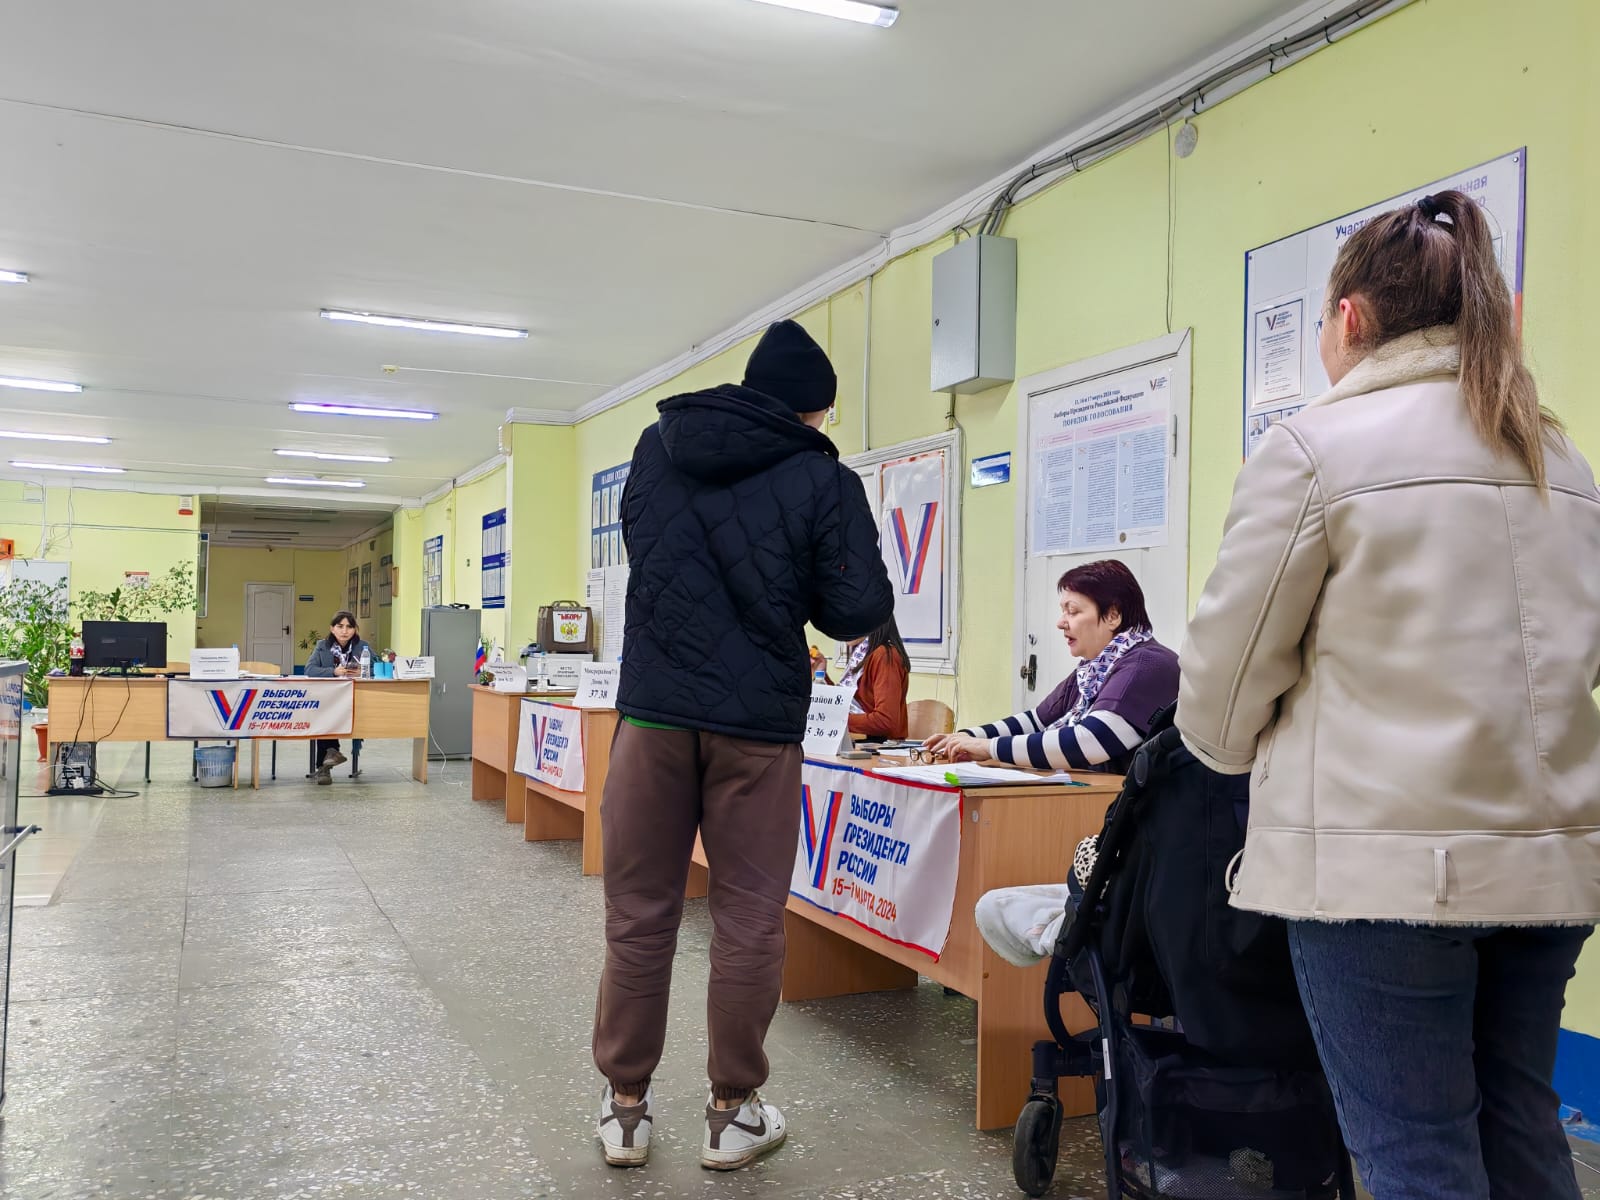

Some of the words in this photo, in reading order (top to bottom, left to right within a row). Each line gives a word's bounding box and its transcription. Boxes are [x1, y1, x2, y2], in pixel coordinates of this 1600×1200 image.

[1336, 218, 1371, 239] Участк
[1094, 397, 1119, 409] Российской
[1062, 415, 1088, 427] ПОРЯДОК
[1089, 404, 1133, 420] ГОЛОСОВАНИЯ
[262, 689, 307, 698] ВЫБОРЫ
[257, 700, 320, 709] ПРЕЗИДЕНТА
[252, 712, 293, 720] РОССИИ
[816, 713, 826, 721] №
[814, 728, 824, 736] 36
[851, 794, 896, 828] ВЫБОРЫ
[843, 822, 910, 866] ПРЕЗИДЕНТА
[875, 898, 896, 922] 2024
